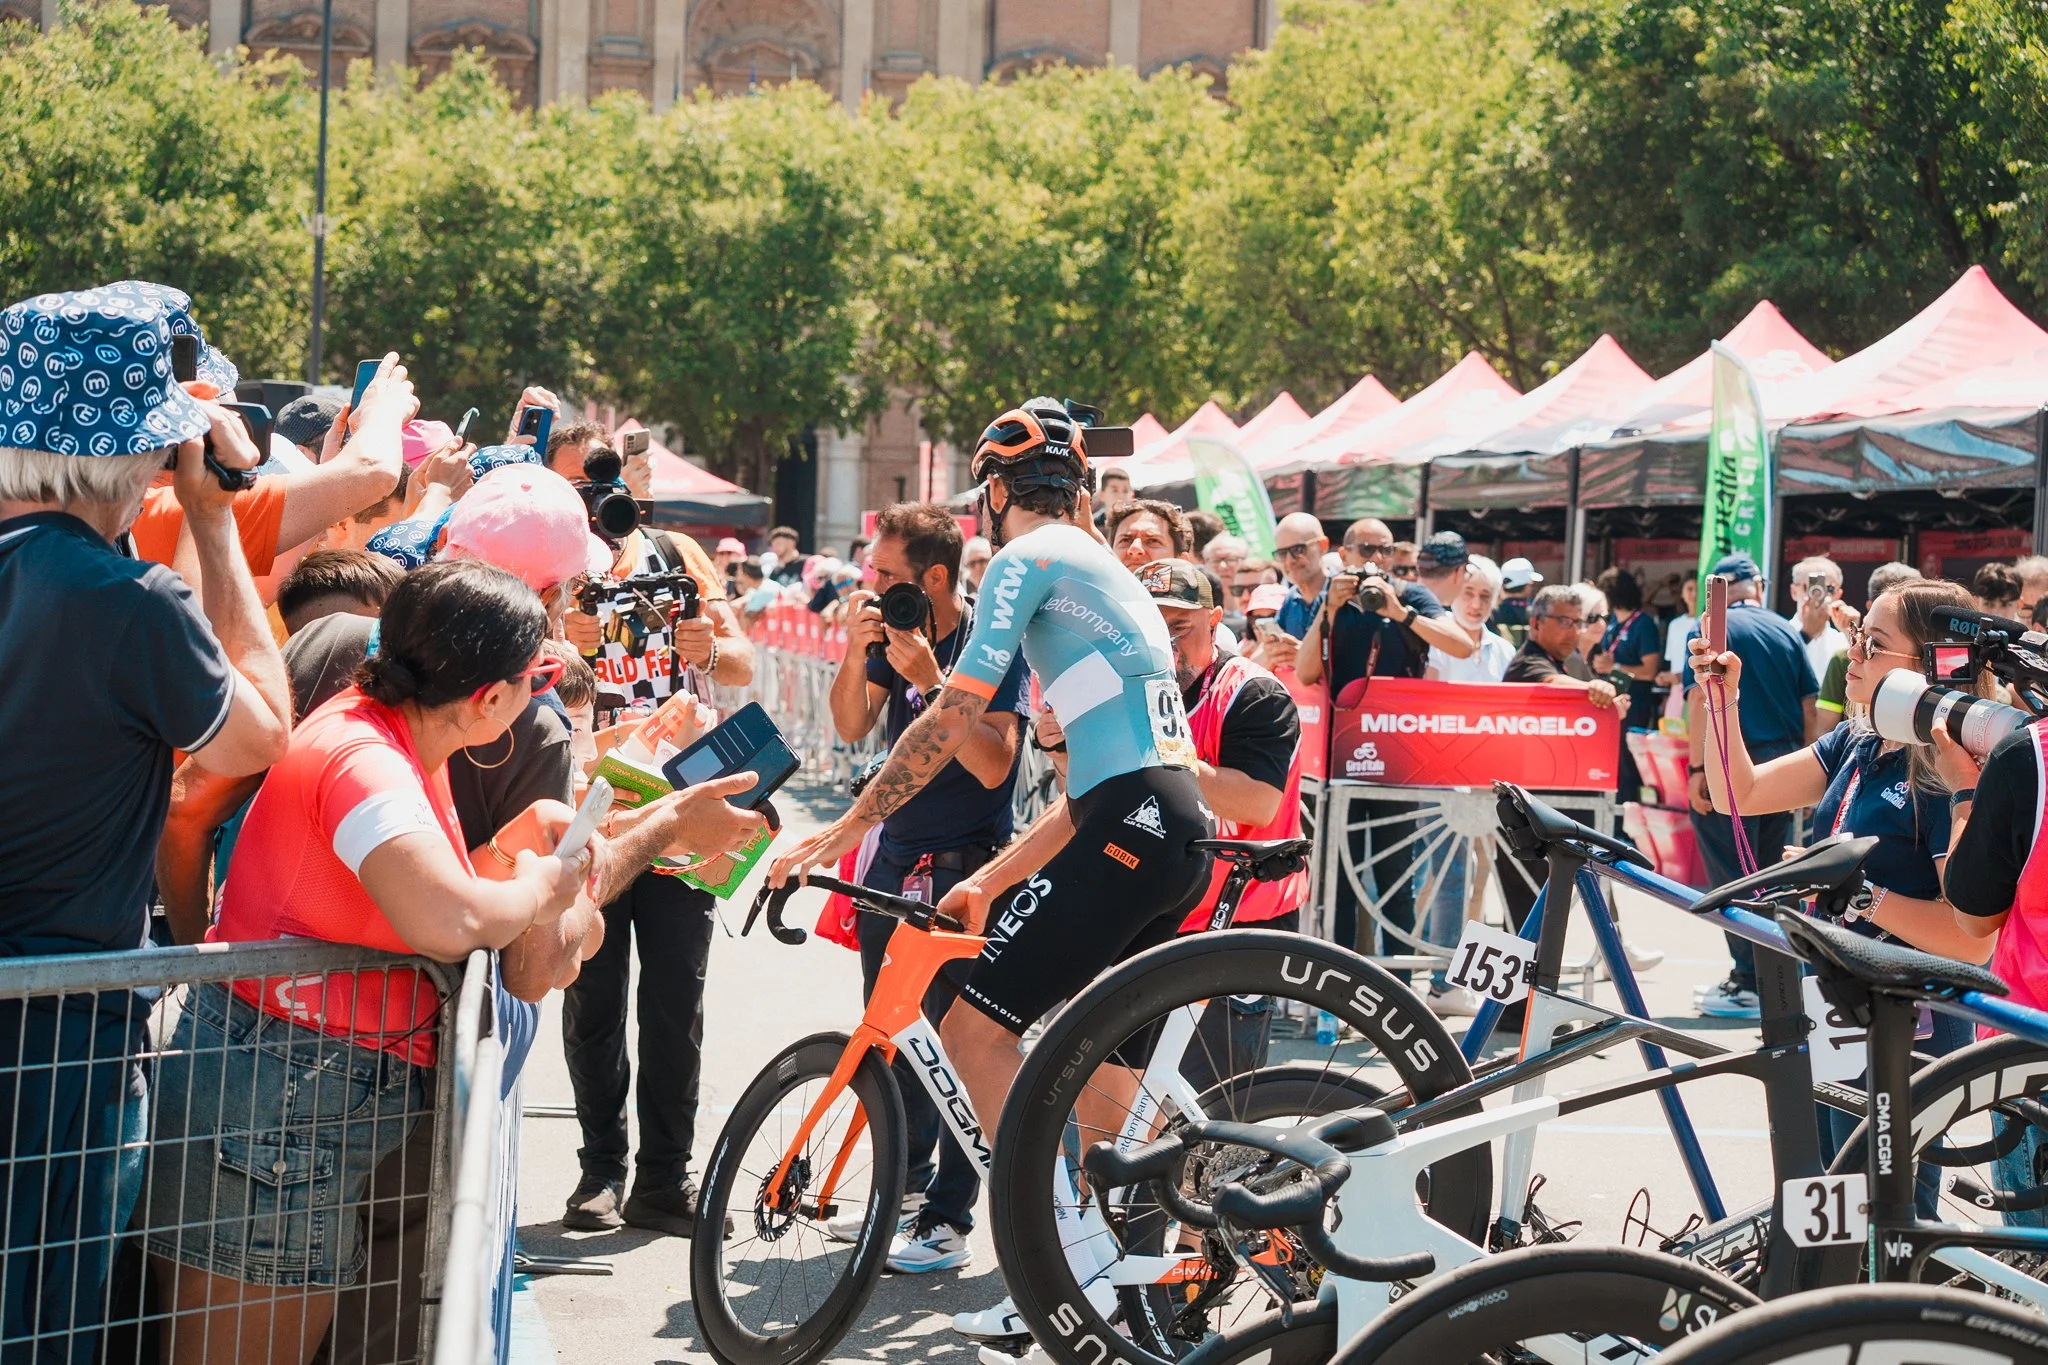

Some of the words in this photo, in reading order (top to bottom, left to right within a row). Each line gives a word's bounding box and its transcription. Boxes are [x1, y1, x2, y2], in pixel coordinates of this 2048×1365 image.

[1045, 445, 1070, 457] KASK
[991, 554, 1028, 629] wtw
[1159, 689, 1185, 738] 9
[1361, 713, 1597, 737] MICHELANGELO
[1106, 845, 1137, 867] GOBIK
[980, 873, 1052, 963] INEOS
[1451, 941, 1522, 999] 153
[908, 1036, 992, 1169] DOGM
[1877, 1092, 1891, 1132] CMA
[1878, 1134, 1892, 1175] CGM
[1804, 1180, 1852, 1242] 31
